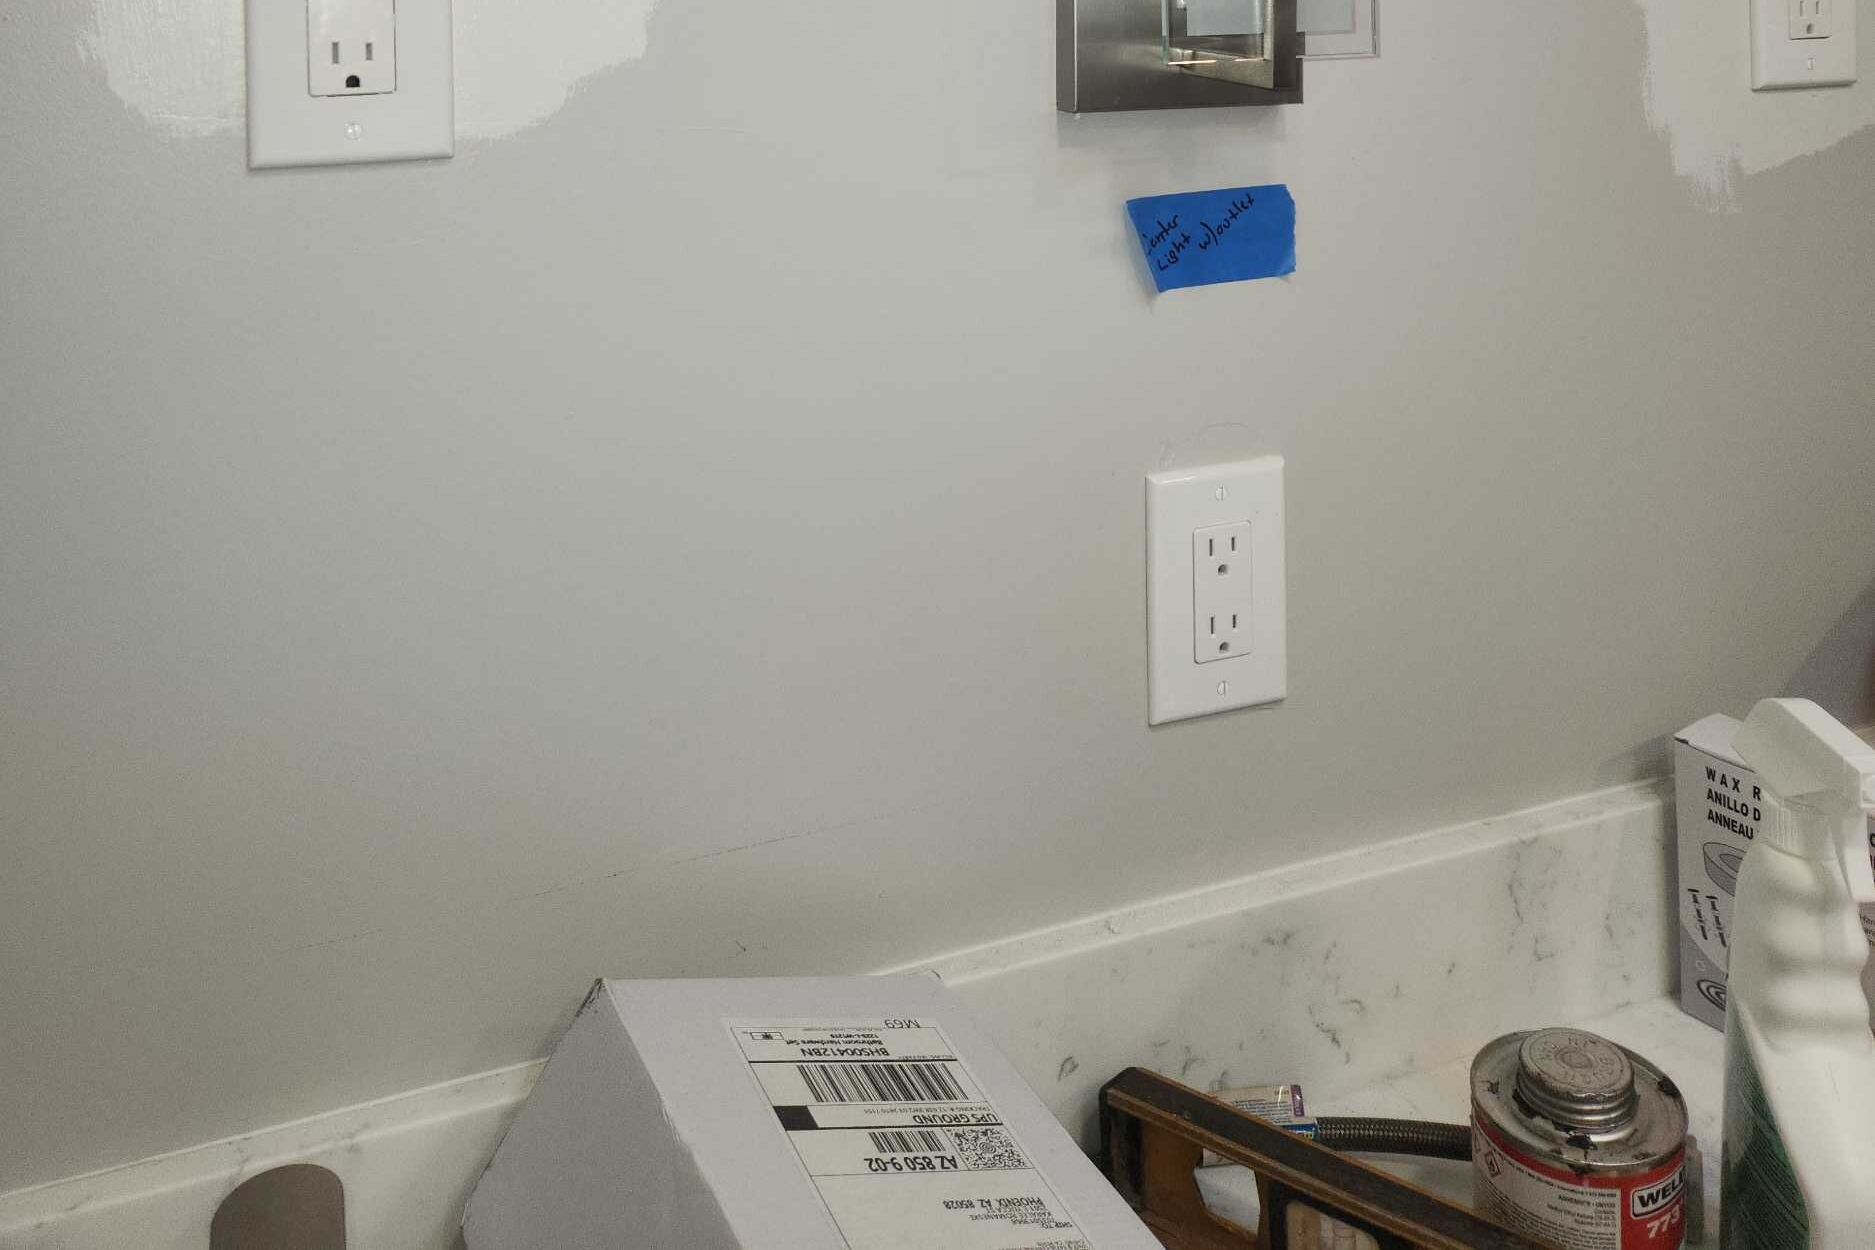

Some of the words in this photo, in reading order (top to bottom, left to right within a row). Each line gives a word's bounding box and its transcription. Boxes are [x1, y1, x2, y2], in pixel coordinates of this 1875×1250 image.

[1157, 232, 1191, 271] Light
[1705, 765, 1740, 793] WAX
[1706, 788, 1749, 817] ANILLO
[1707, 809, 1754, 840] ANNEAU
[884, 1019, 921, 1029] M69
[913, 1114, 970, 1124] GROUND
[970, 1113, 999, 1123] UPS
[864, 1157, 903, 1172] 9-02
[904, 1156, 936, 1171] 850
[935, 1156, 959, 1170] AZ
[1637, 1170, 1684, 1209] WEL
[996, 1197, 1046, 1208] PHOENIX
